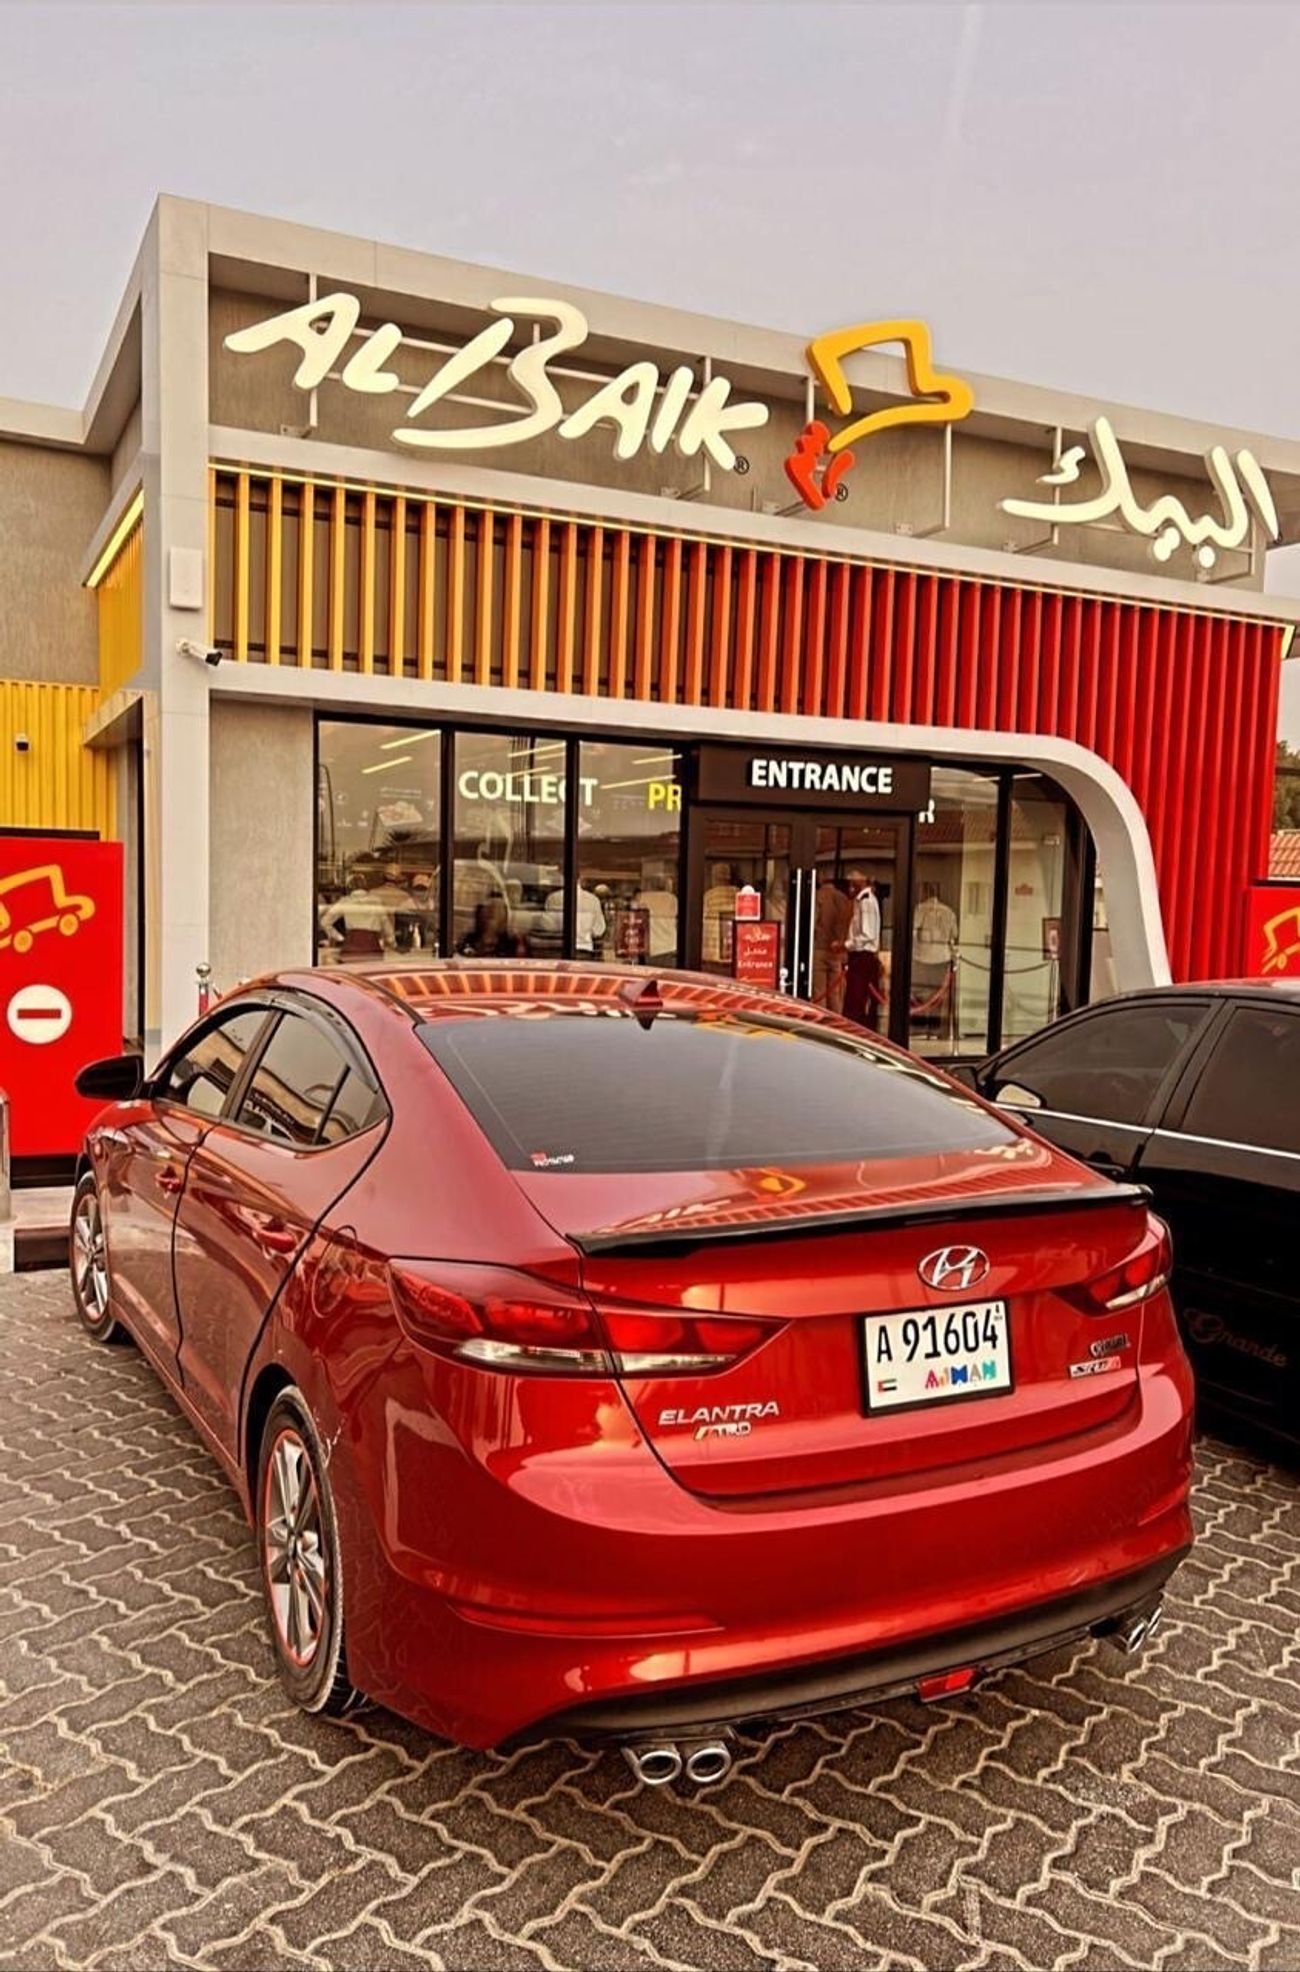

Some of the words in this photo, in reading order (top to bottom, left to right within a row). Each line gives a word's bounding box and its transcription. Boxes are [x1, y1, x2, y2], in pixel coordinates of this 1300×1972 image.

[1002, 416, 1279, 568] البيك
[751, 758, 893, 794] ENTRANCE
[876, 1324, 893, 1363] A
[902, 1308, 998, 1362] 91604
[1183, 1307, 1288, 1367] Grande
[659, 1401, 780, 1425] ELANTRA
